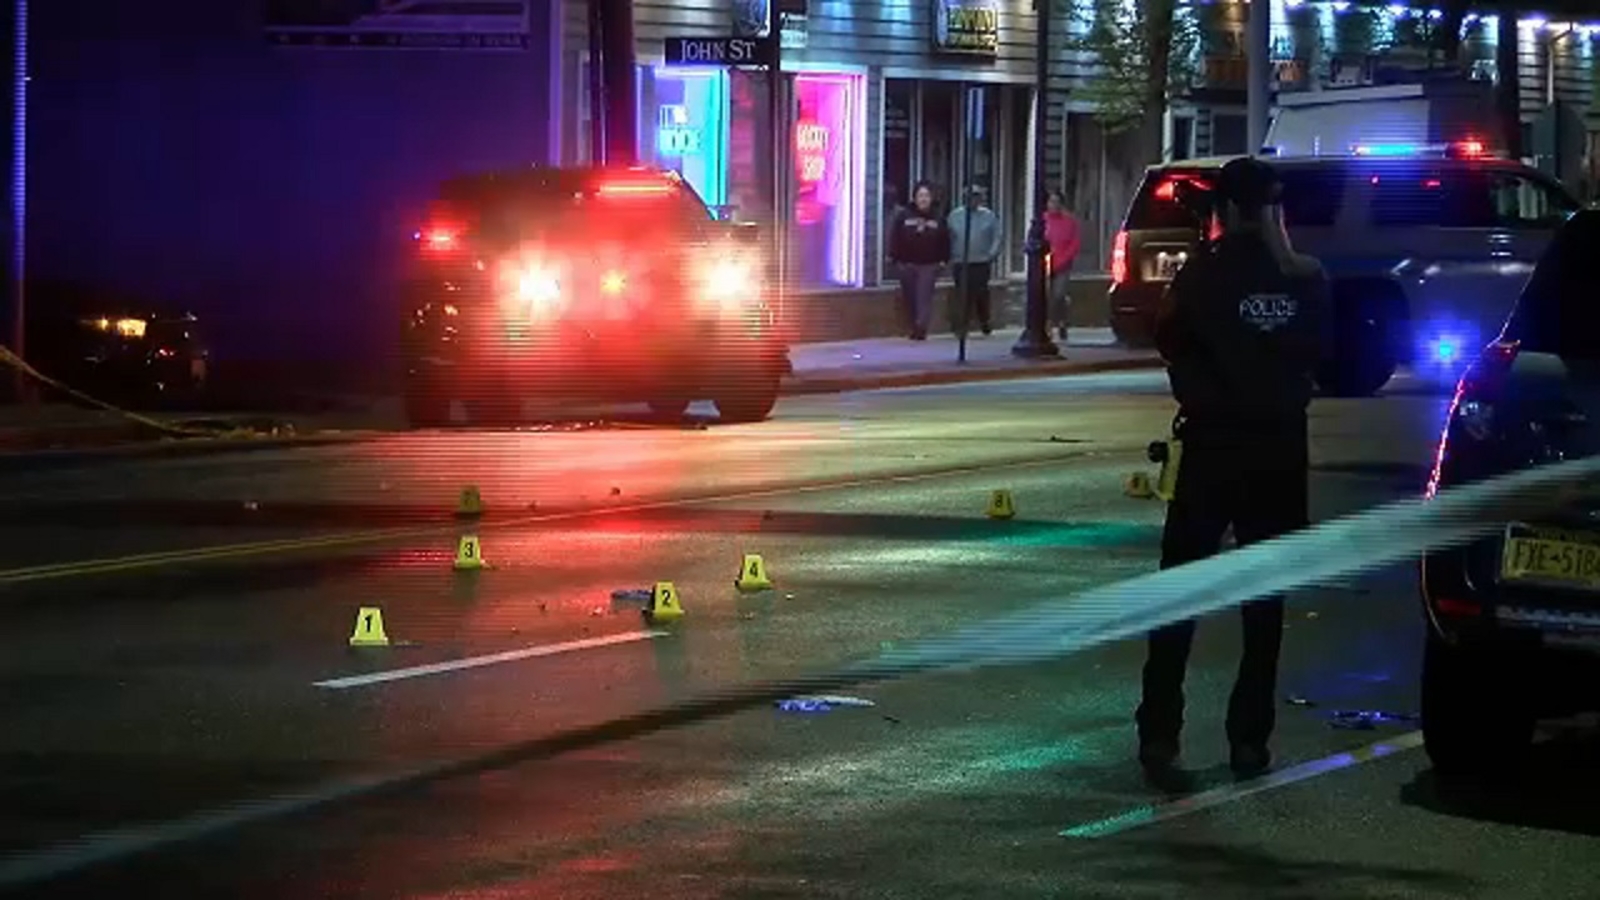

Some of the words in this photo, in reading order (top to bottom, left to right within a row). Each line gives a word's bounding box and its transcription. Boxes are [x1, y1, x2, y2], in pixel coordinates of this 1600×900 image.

[680, 39, 725, 63] JOHN
[729, 39, 756, 60] ST
[1239, 299, 1296, 316] POLICE
[464, 541, 474, 558] 3
[749, 561, 759, 578] 4
[661, 589, 671, 607] 2
[364, 613, 373, 633] 1
